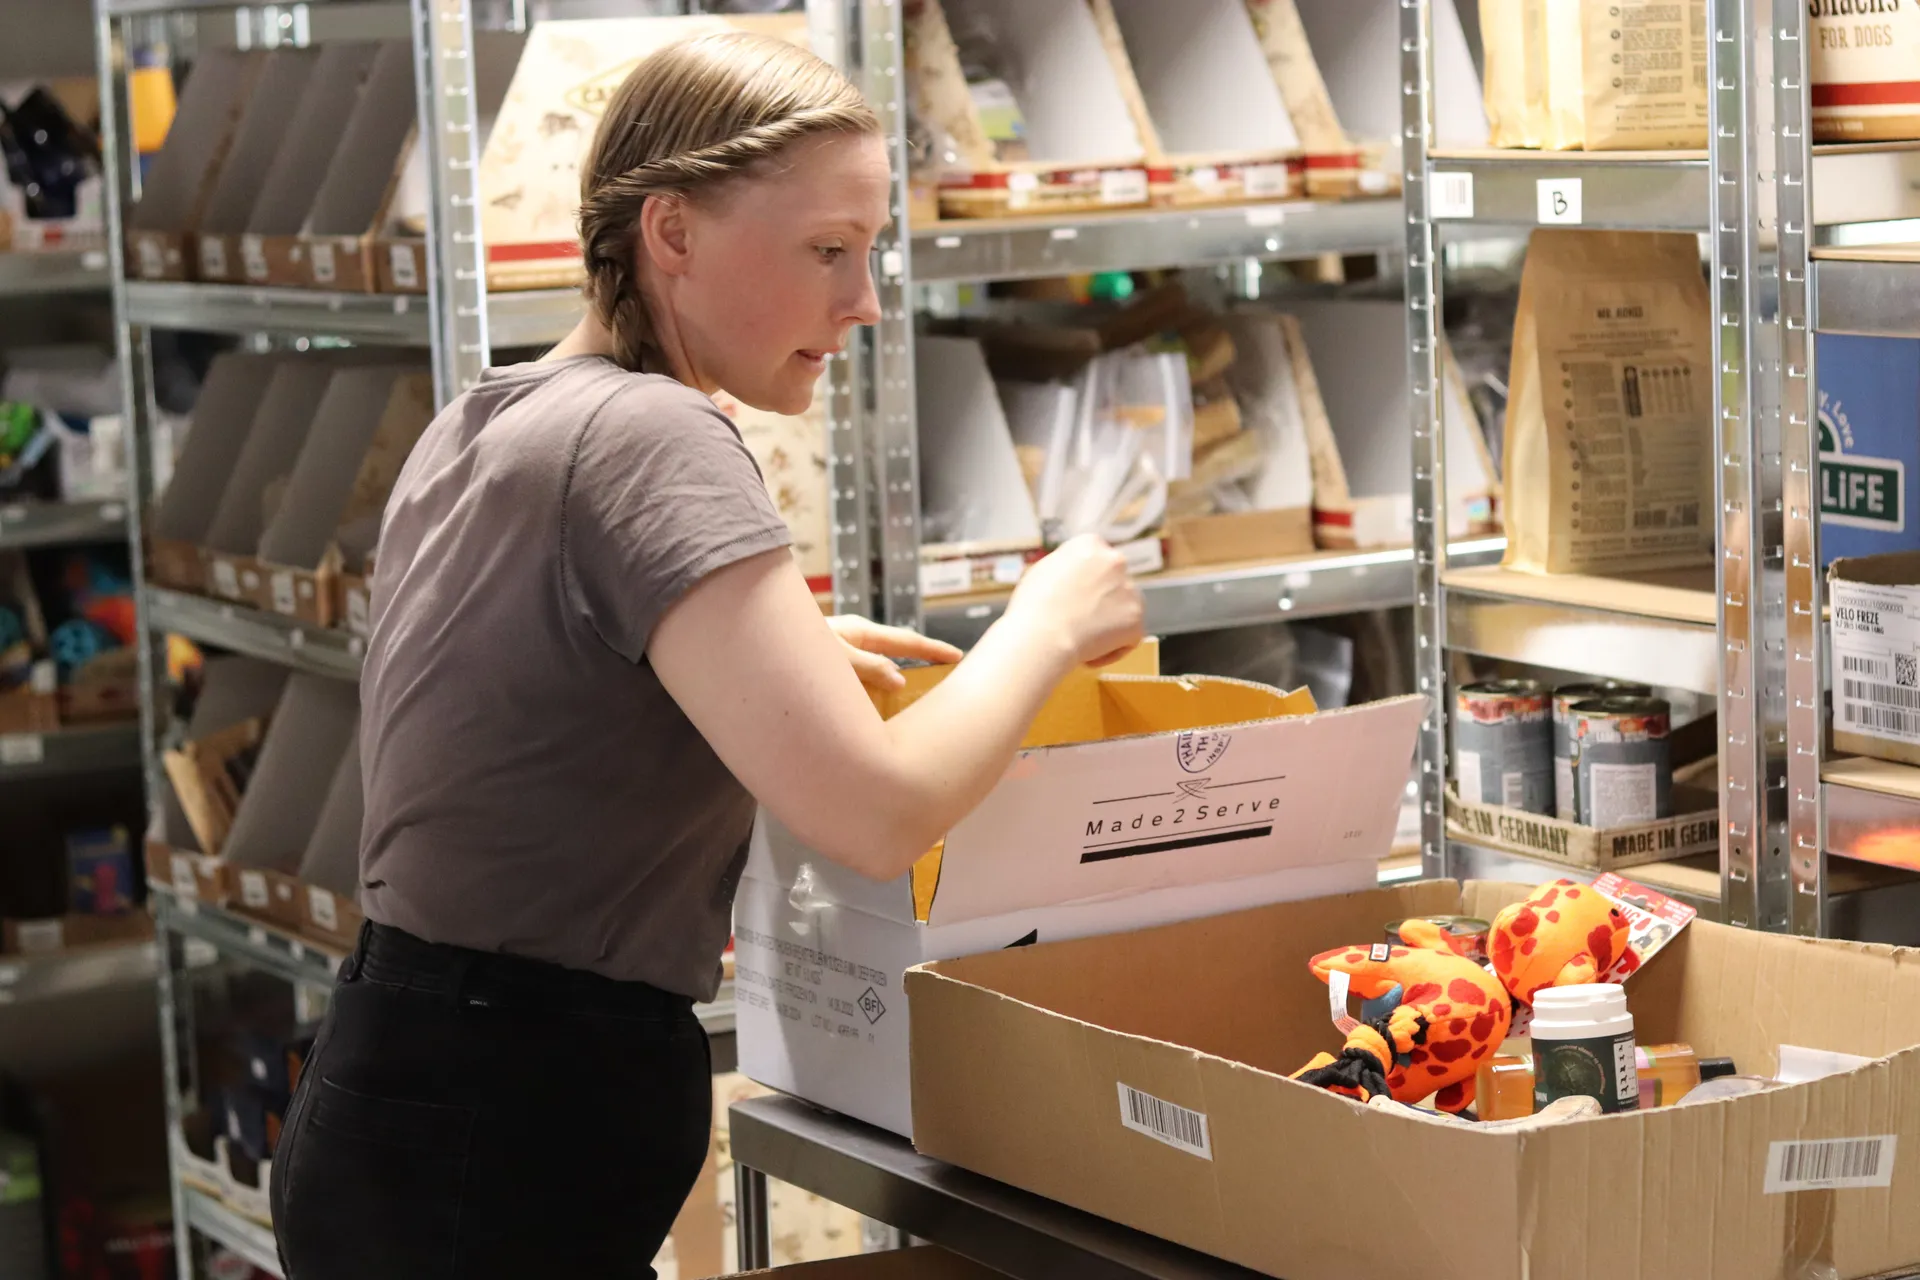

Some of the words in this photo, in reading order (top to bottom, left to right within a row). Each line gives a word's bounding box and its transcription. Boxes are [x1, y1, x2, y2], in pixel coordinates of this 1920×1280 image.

[1819, 26, 1848, 49] FOR
[1854, 24, 1893, 47] DOGS
[1552, 191, 1568, 215] B
[1833, 400, 1854, 448] Love
[1835, 606, 1855, 622] VELO
[1857, 610, 1880, 626] FREZE
[1180, 732, 1196, 766] THAIL
[1474, 809, 1494, 837] IN
[1498, 815, 1569, 856] GERMANY
[1612, 831, 1655, 858] MADE
[1658, 828, 1675, 849] IN
[1681, 818, 1720, 847] GERM
